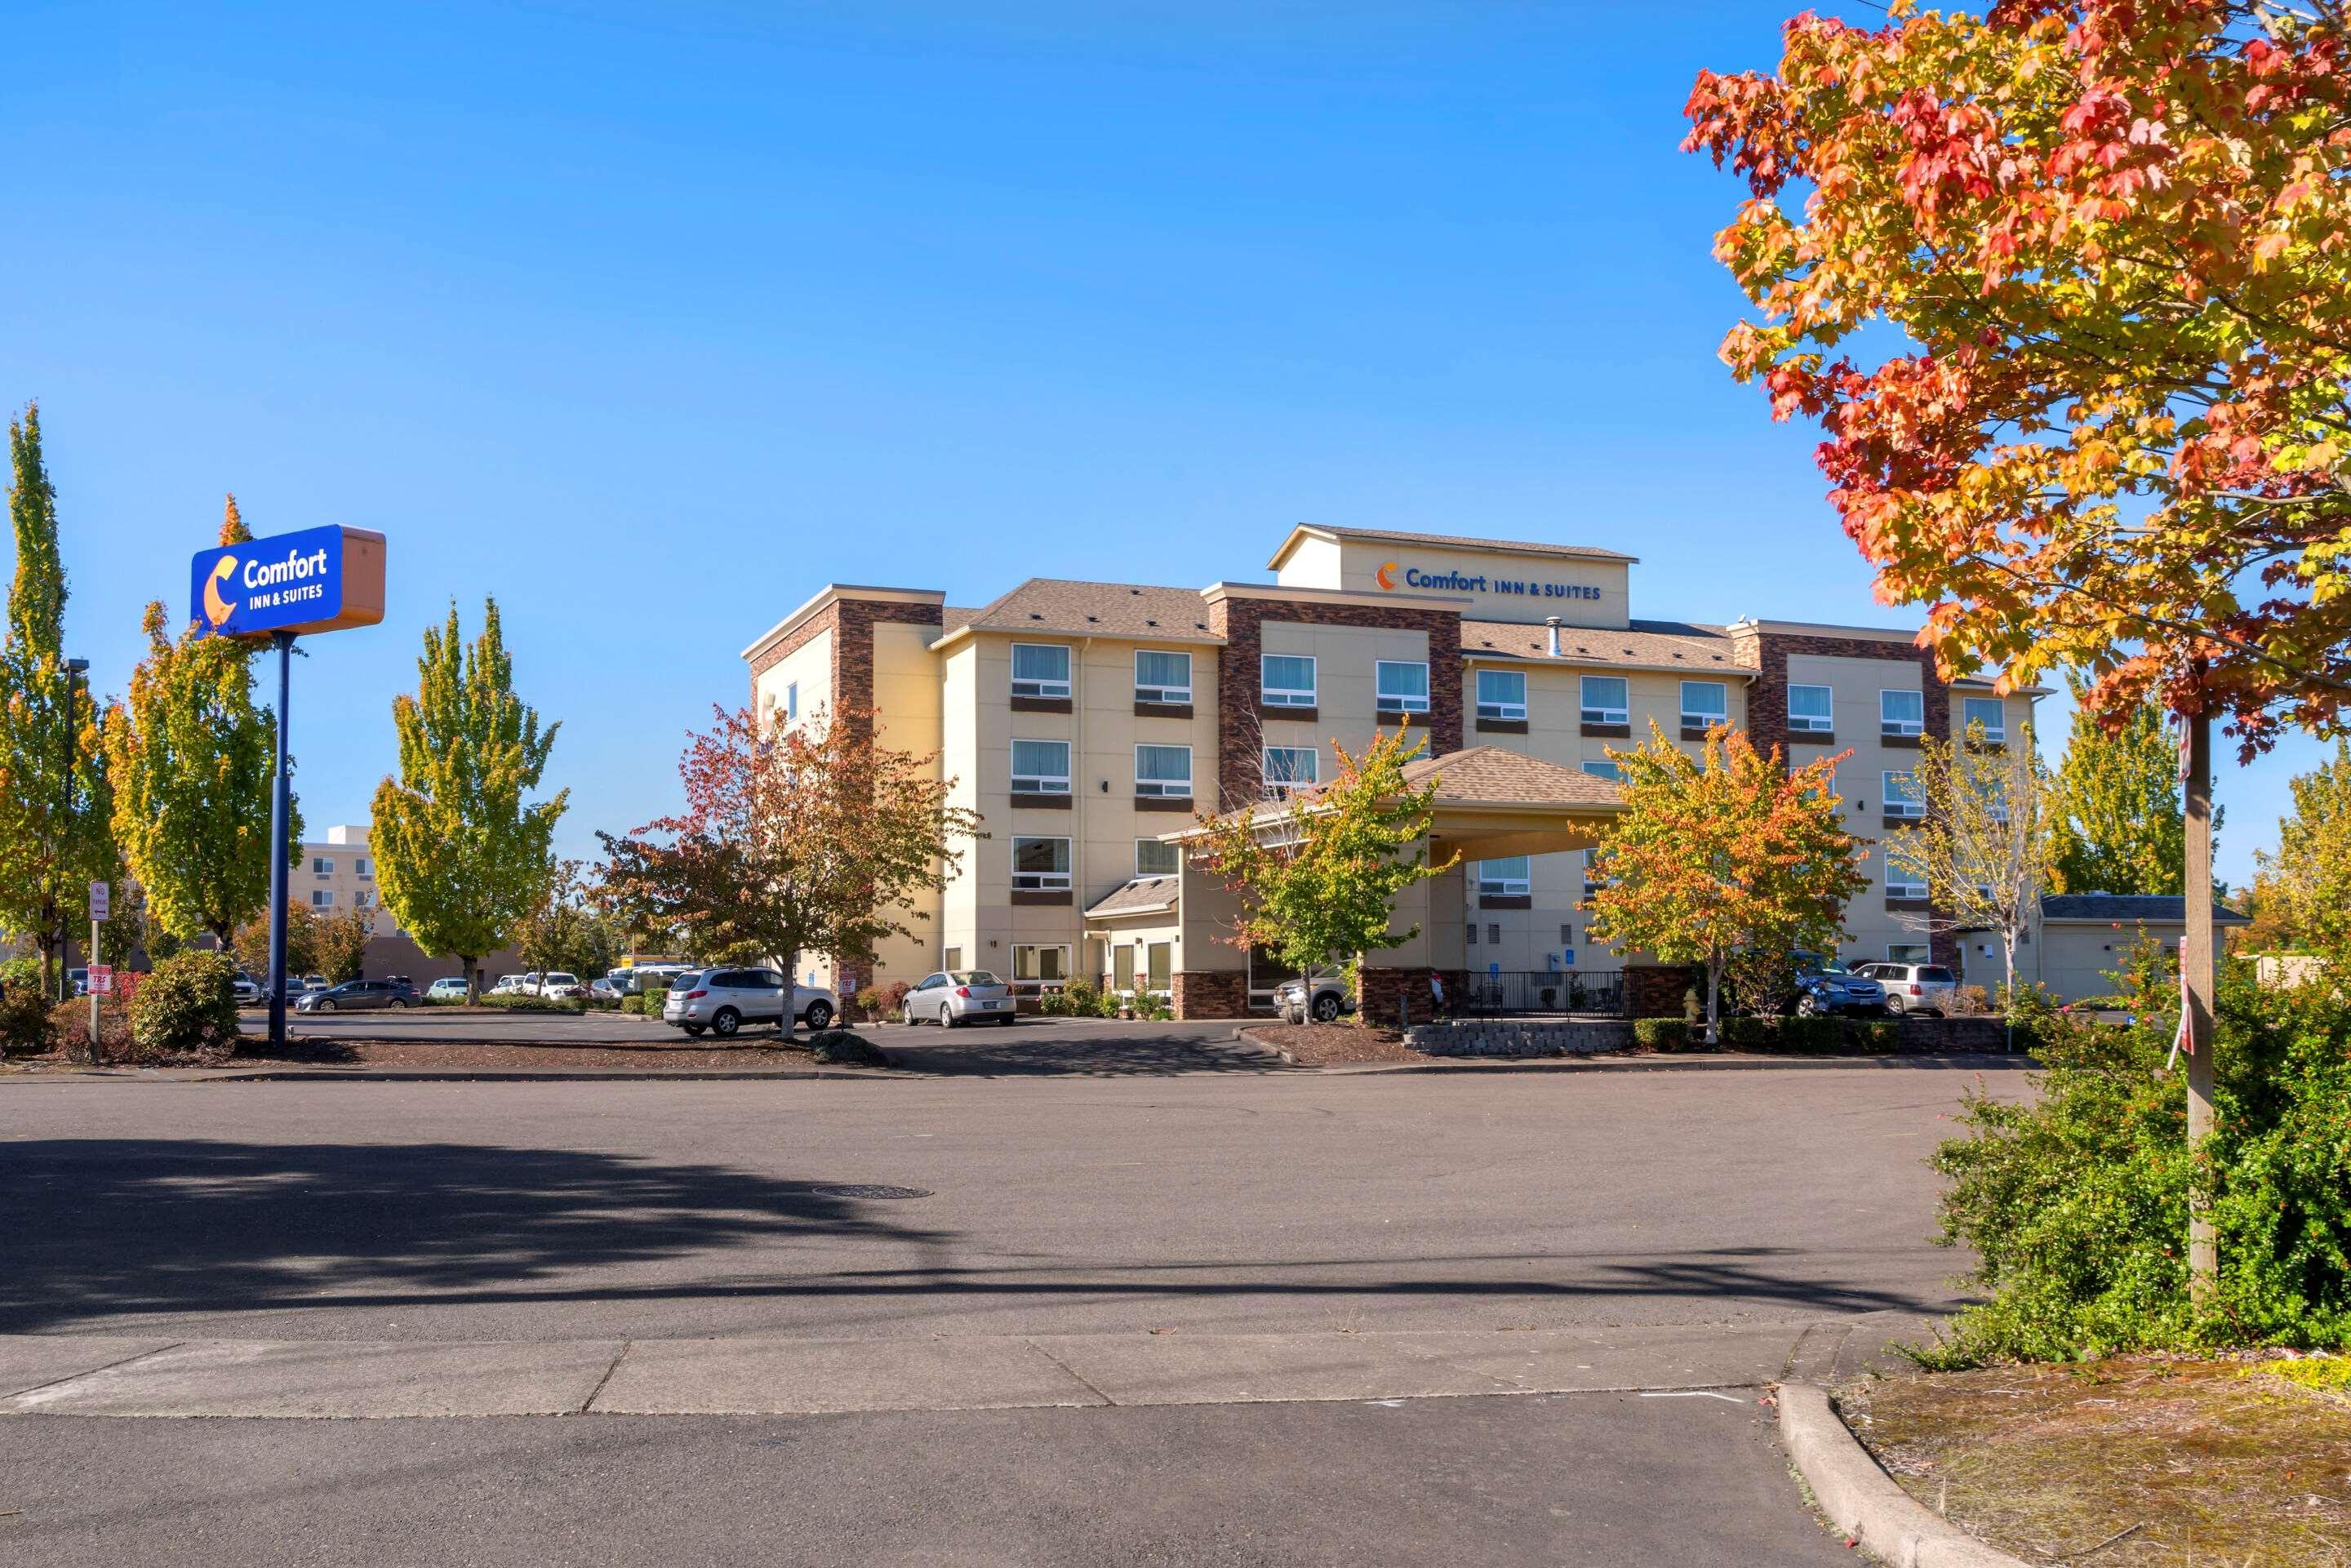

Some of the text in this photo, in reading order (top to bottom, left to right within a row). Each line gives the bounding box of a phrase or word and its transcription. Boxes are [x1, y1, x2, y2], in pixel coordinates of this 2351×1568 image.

[243, 549, 327, 589] Comfort
[1405, 568, 1601, 600] Comfort INN & SUITES
[249, 584, 322, 610] INN & SUITES
